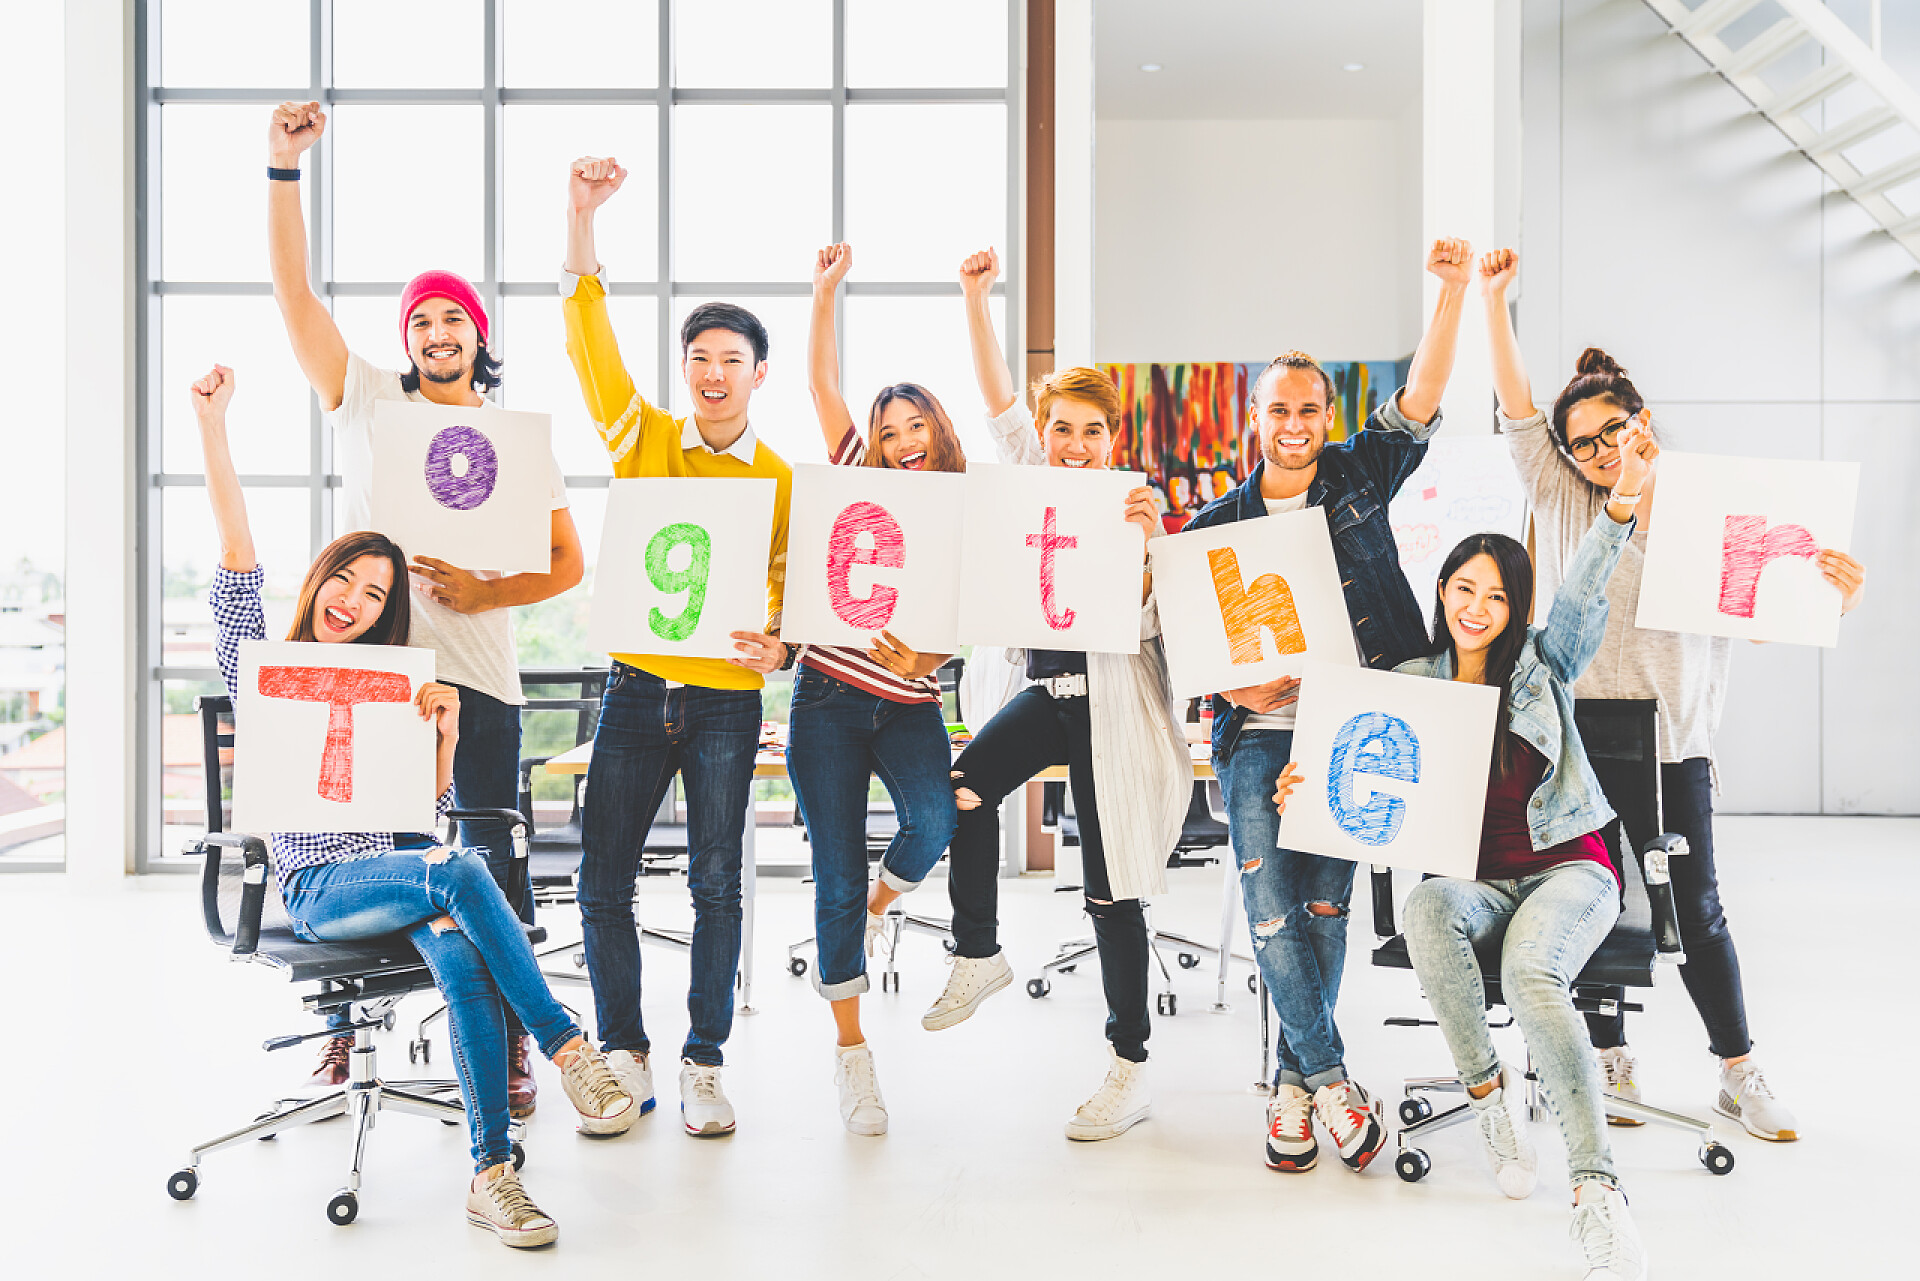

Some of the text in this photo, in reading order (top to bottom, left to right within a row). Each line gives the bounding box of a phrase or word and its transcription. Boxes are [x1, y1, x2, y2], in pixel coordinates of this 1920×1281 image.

[425, 425, 497, 510] o
[645, 522, 711, 641] g
[826, 501, 905, 630] e
[1026, 506, 1078, 630] t
[1207, 546, 1307, 665] h
[1718, 514, 1820, 618] r
[258, 665, 411, 803] T
[1327, 711, 1420, 846] e
